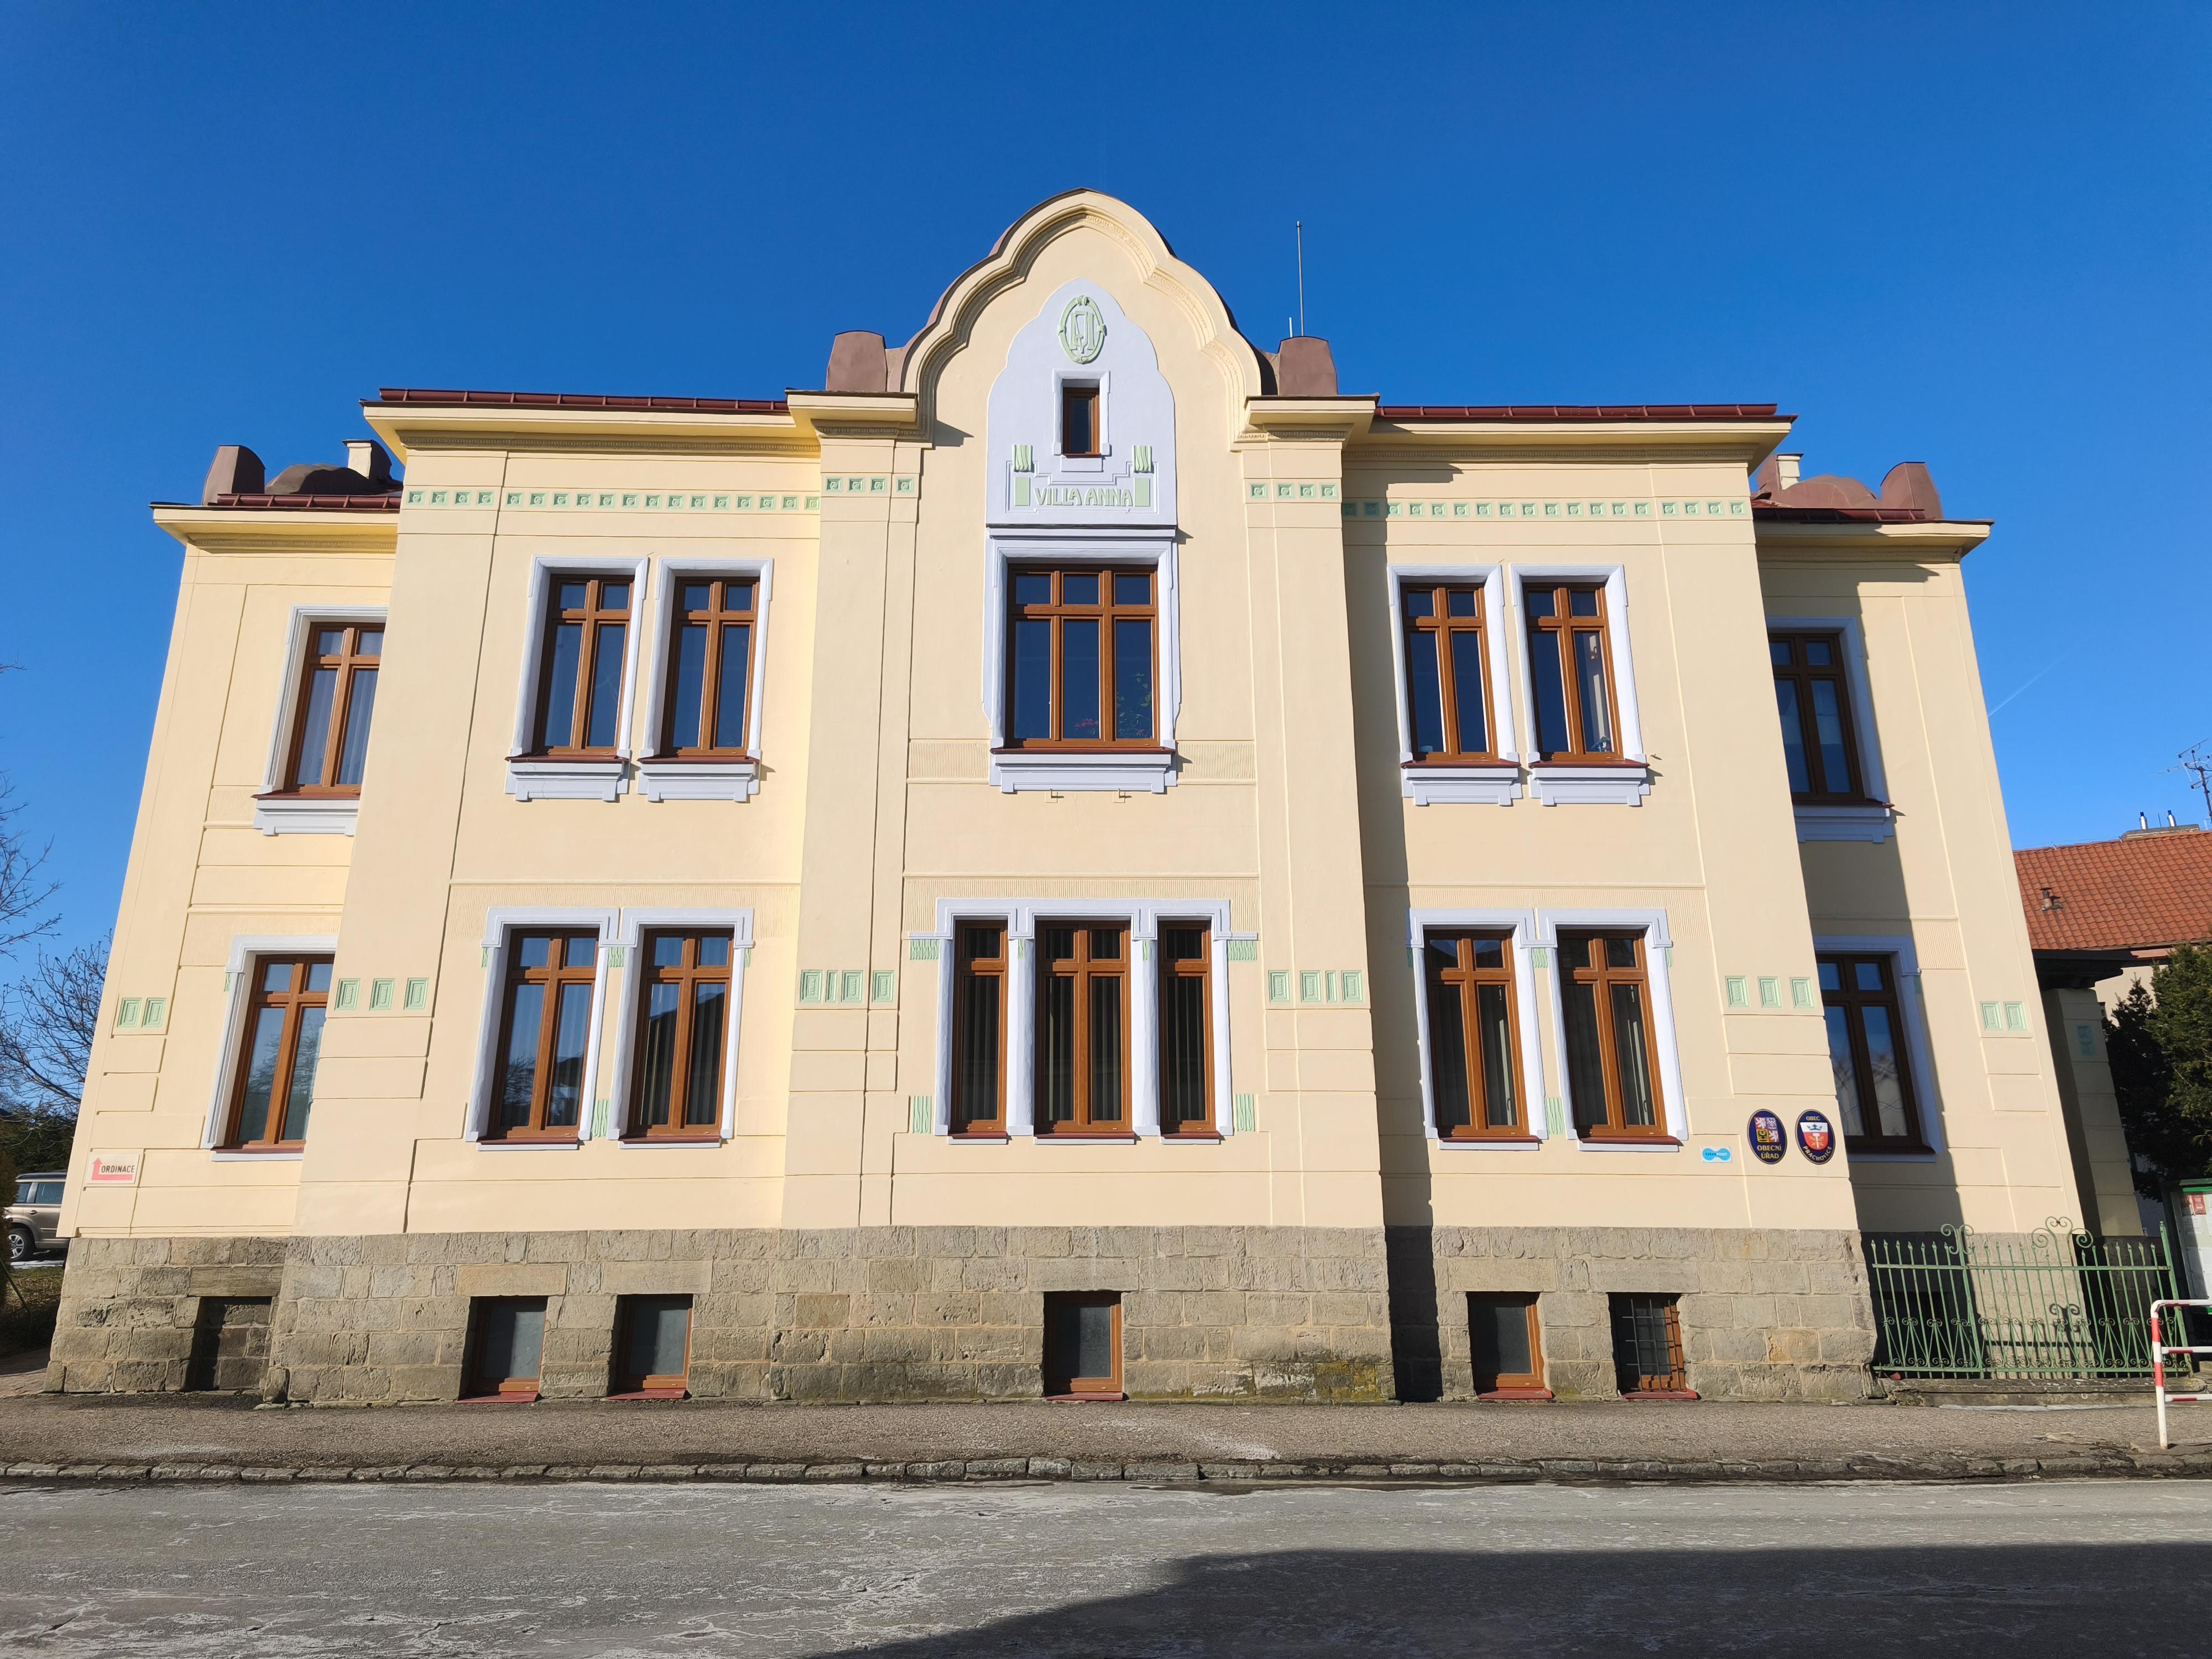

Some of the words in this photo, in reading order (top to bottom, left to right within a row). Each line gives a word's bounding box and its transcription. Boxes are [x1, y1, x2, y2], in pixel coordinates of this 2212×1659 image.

[1034, 487, 1082, 505] VILLA
[1085, 488, 1133, 507] ANNA
[1803, 1145, 1832, 1161] PRACHOVICE
